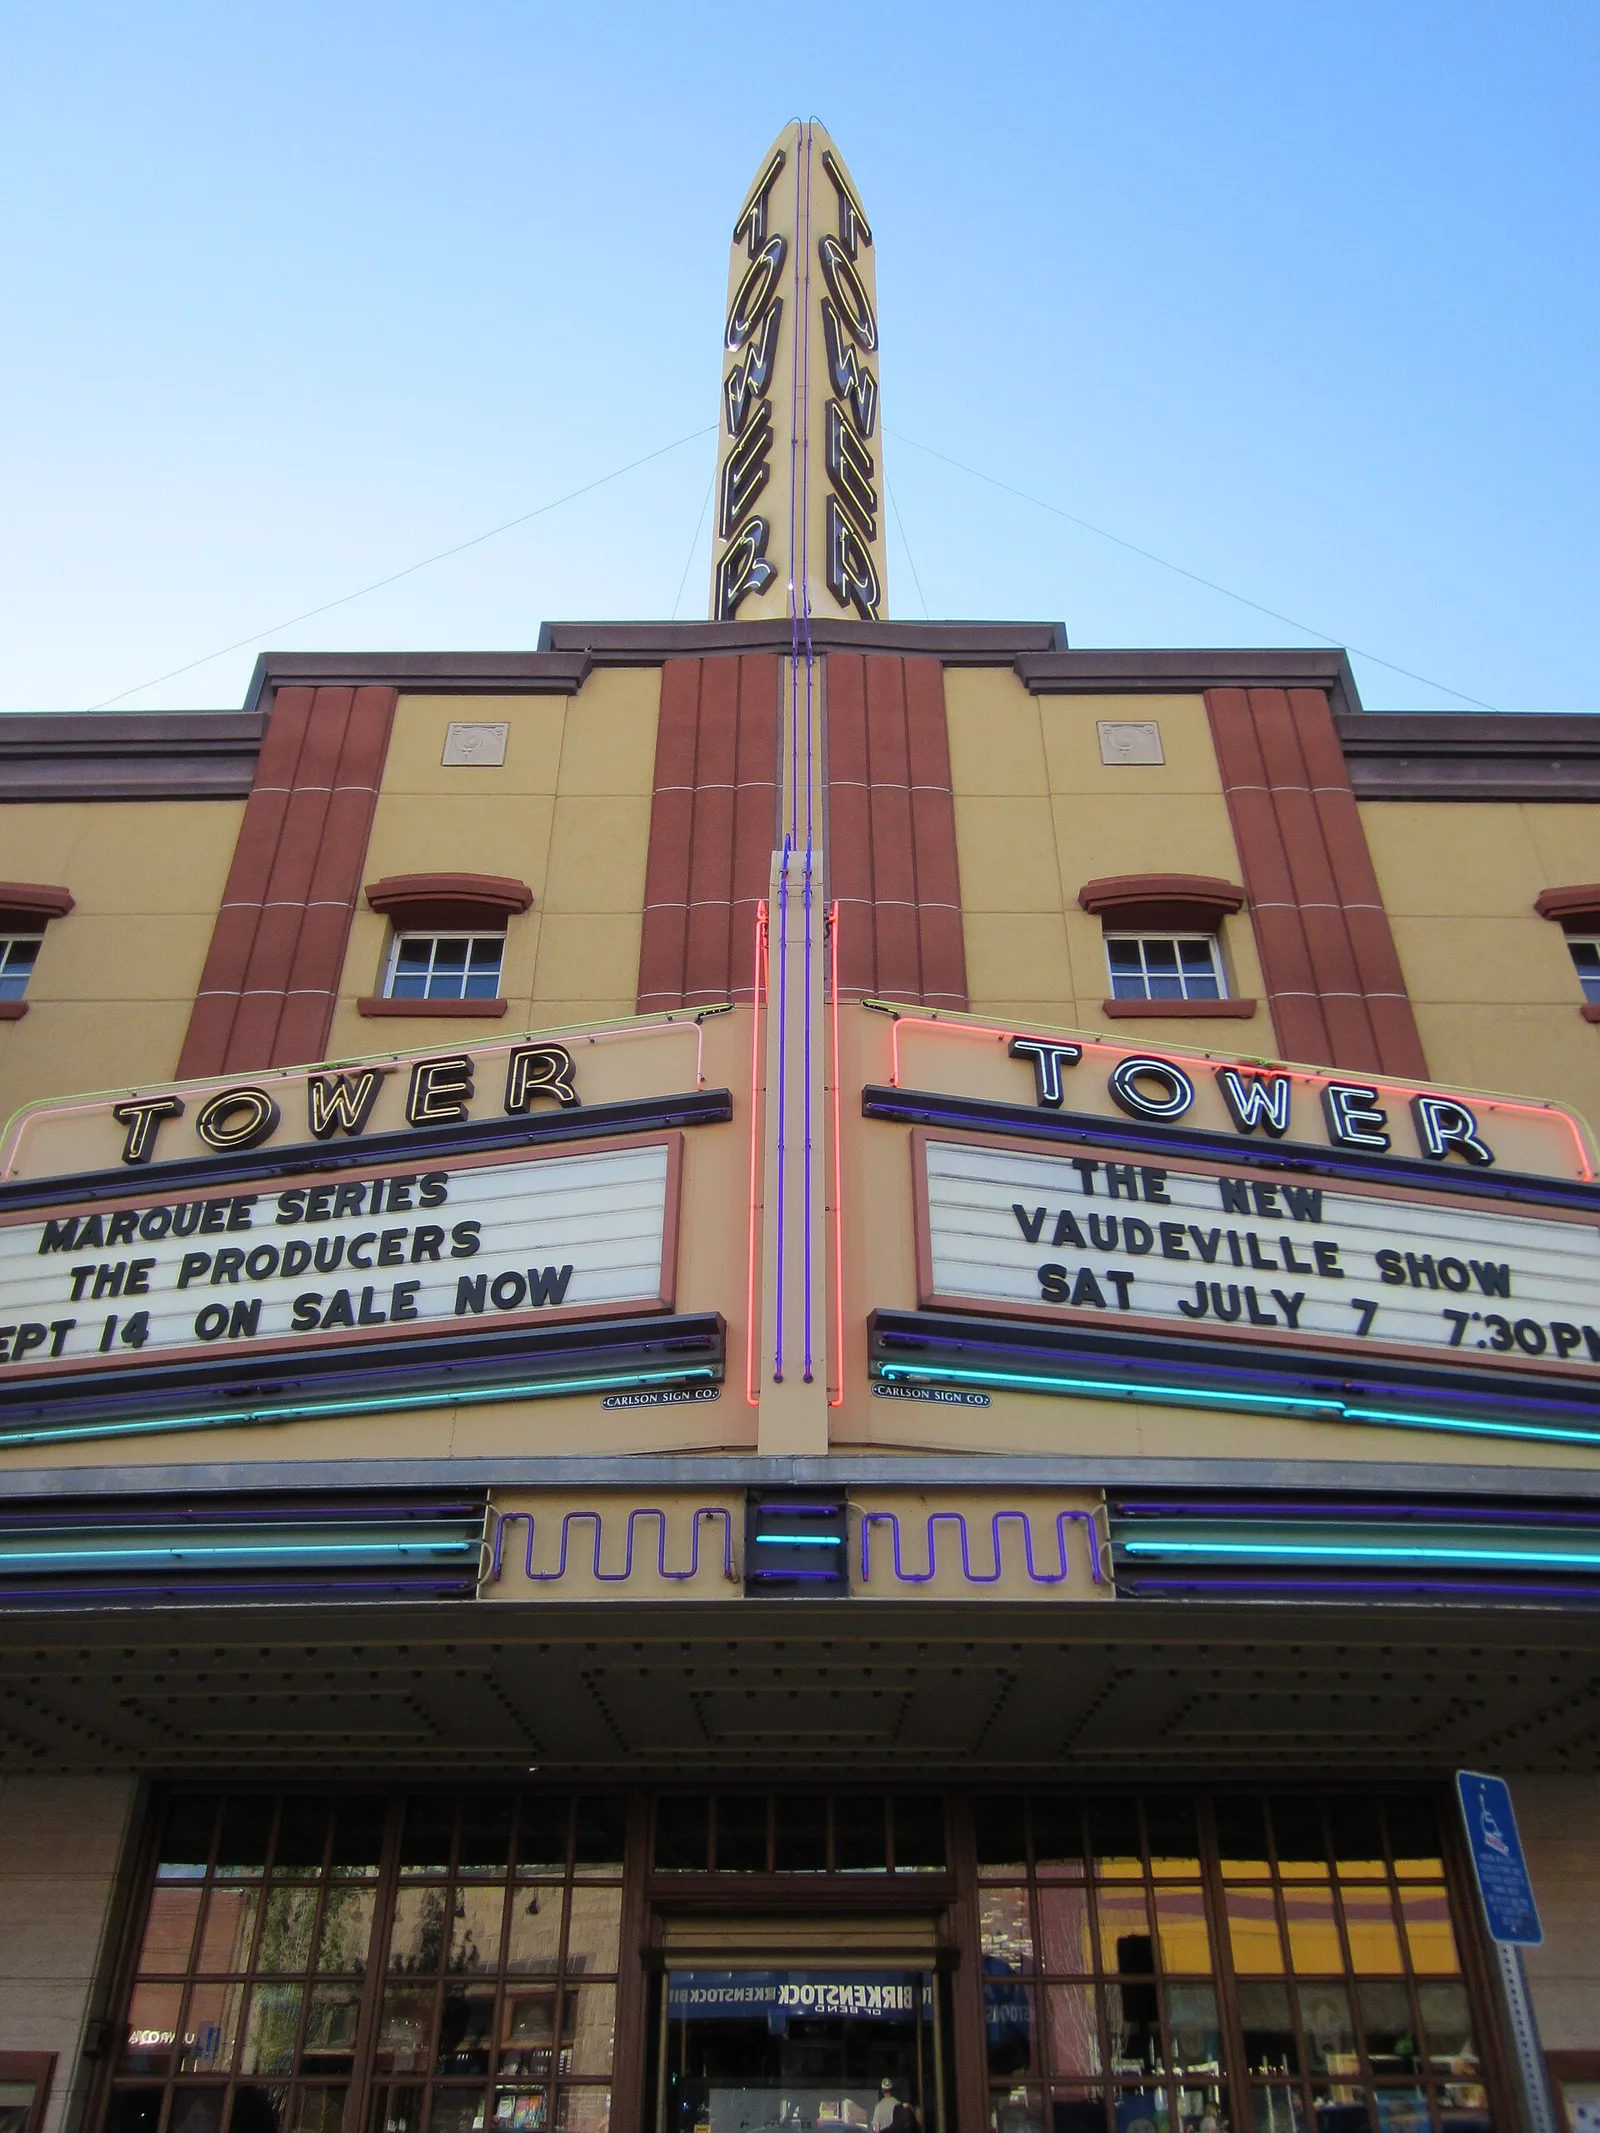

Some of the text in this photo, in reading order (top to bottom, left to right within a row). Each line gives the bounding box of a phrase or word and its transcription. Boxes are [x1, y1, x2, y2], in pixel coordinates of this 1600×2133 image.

[716, 149, 787, 622] TOWER
[818, 149, 880, 622] TOWER
[114, 1043, 581, 1164] TOWER
[1008, 1036, 1495, 1166] TOWER
[38, 1172, 449, 1254] MARQUEE SERIES
[1072, 1158, 1323, 1223] THE NEW
[69, 1221, 481, 1301] THE PRODUCERS
[1012, 1204, 1511, 1298] VAUDEVILLE SHOW
[99, 1310, 149, 1351] 14
[195, 1298, 261, 1339] ON
[291, 1279, 420, 1330] SALE
[455, 1265, 573, 1315] NOW
[1038, 1263, 1135, 1310] SAT
[1178, 1281, 1305, 1329] JULY
[1351, 1299, 1378, 1336] 7
[606, 1394, 658, 1407] CARLSON
[662, 1391, 690, 1402] SIGN
[877, 1385, 930, 1399] CARLSON
[934, 1391, 962, 1403] SIGN
